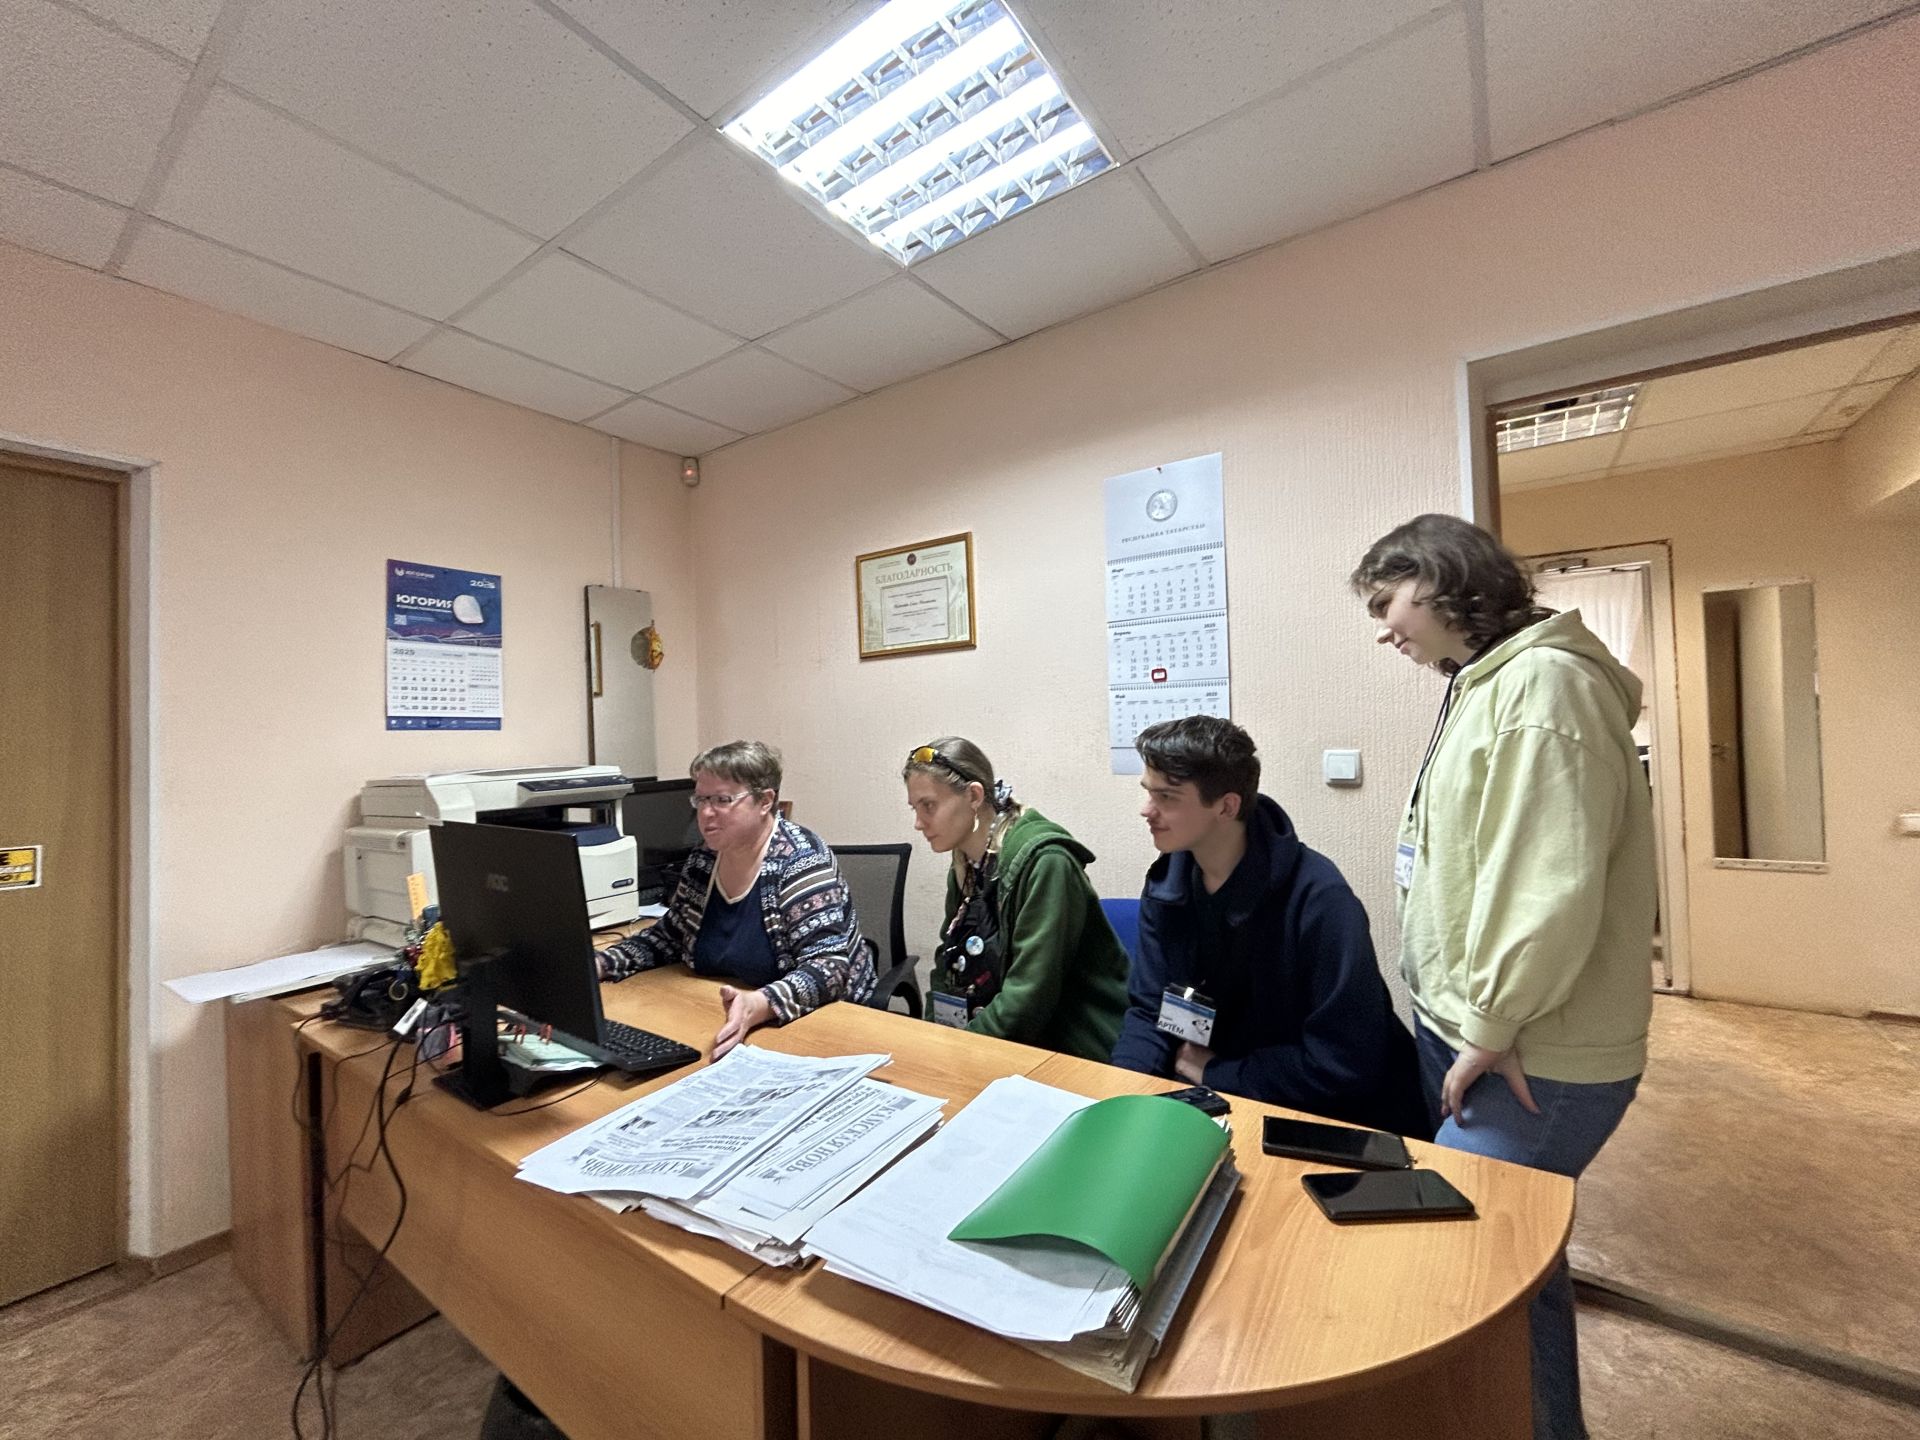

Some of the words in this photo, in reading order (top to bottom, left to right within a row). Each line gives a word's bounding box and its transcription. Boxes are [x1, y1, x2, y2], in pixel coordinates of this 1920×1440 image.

[875, 563, 953, 584] БЛАГОДАРНОСТЬ
[396, 594, 453, 609] ЮГОРИЯ
[826, 1106, 896, 1148] КАМСКАЯ
[785, 1146, 834, 1172] НОВЬ
